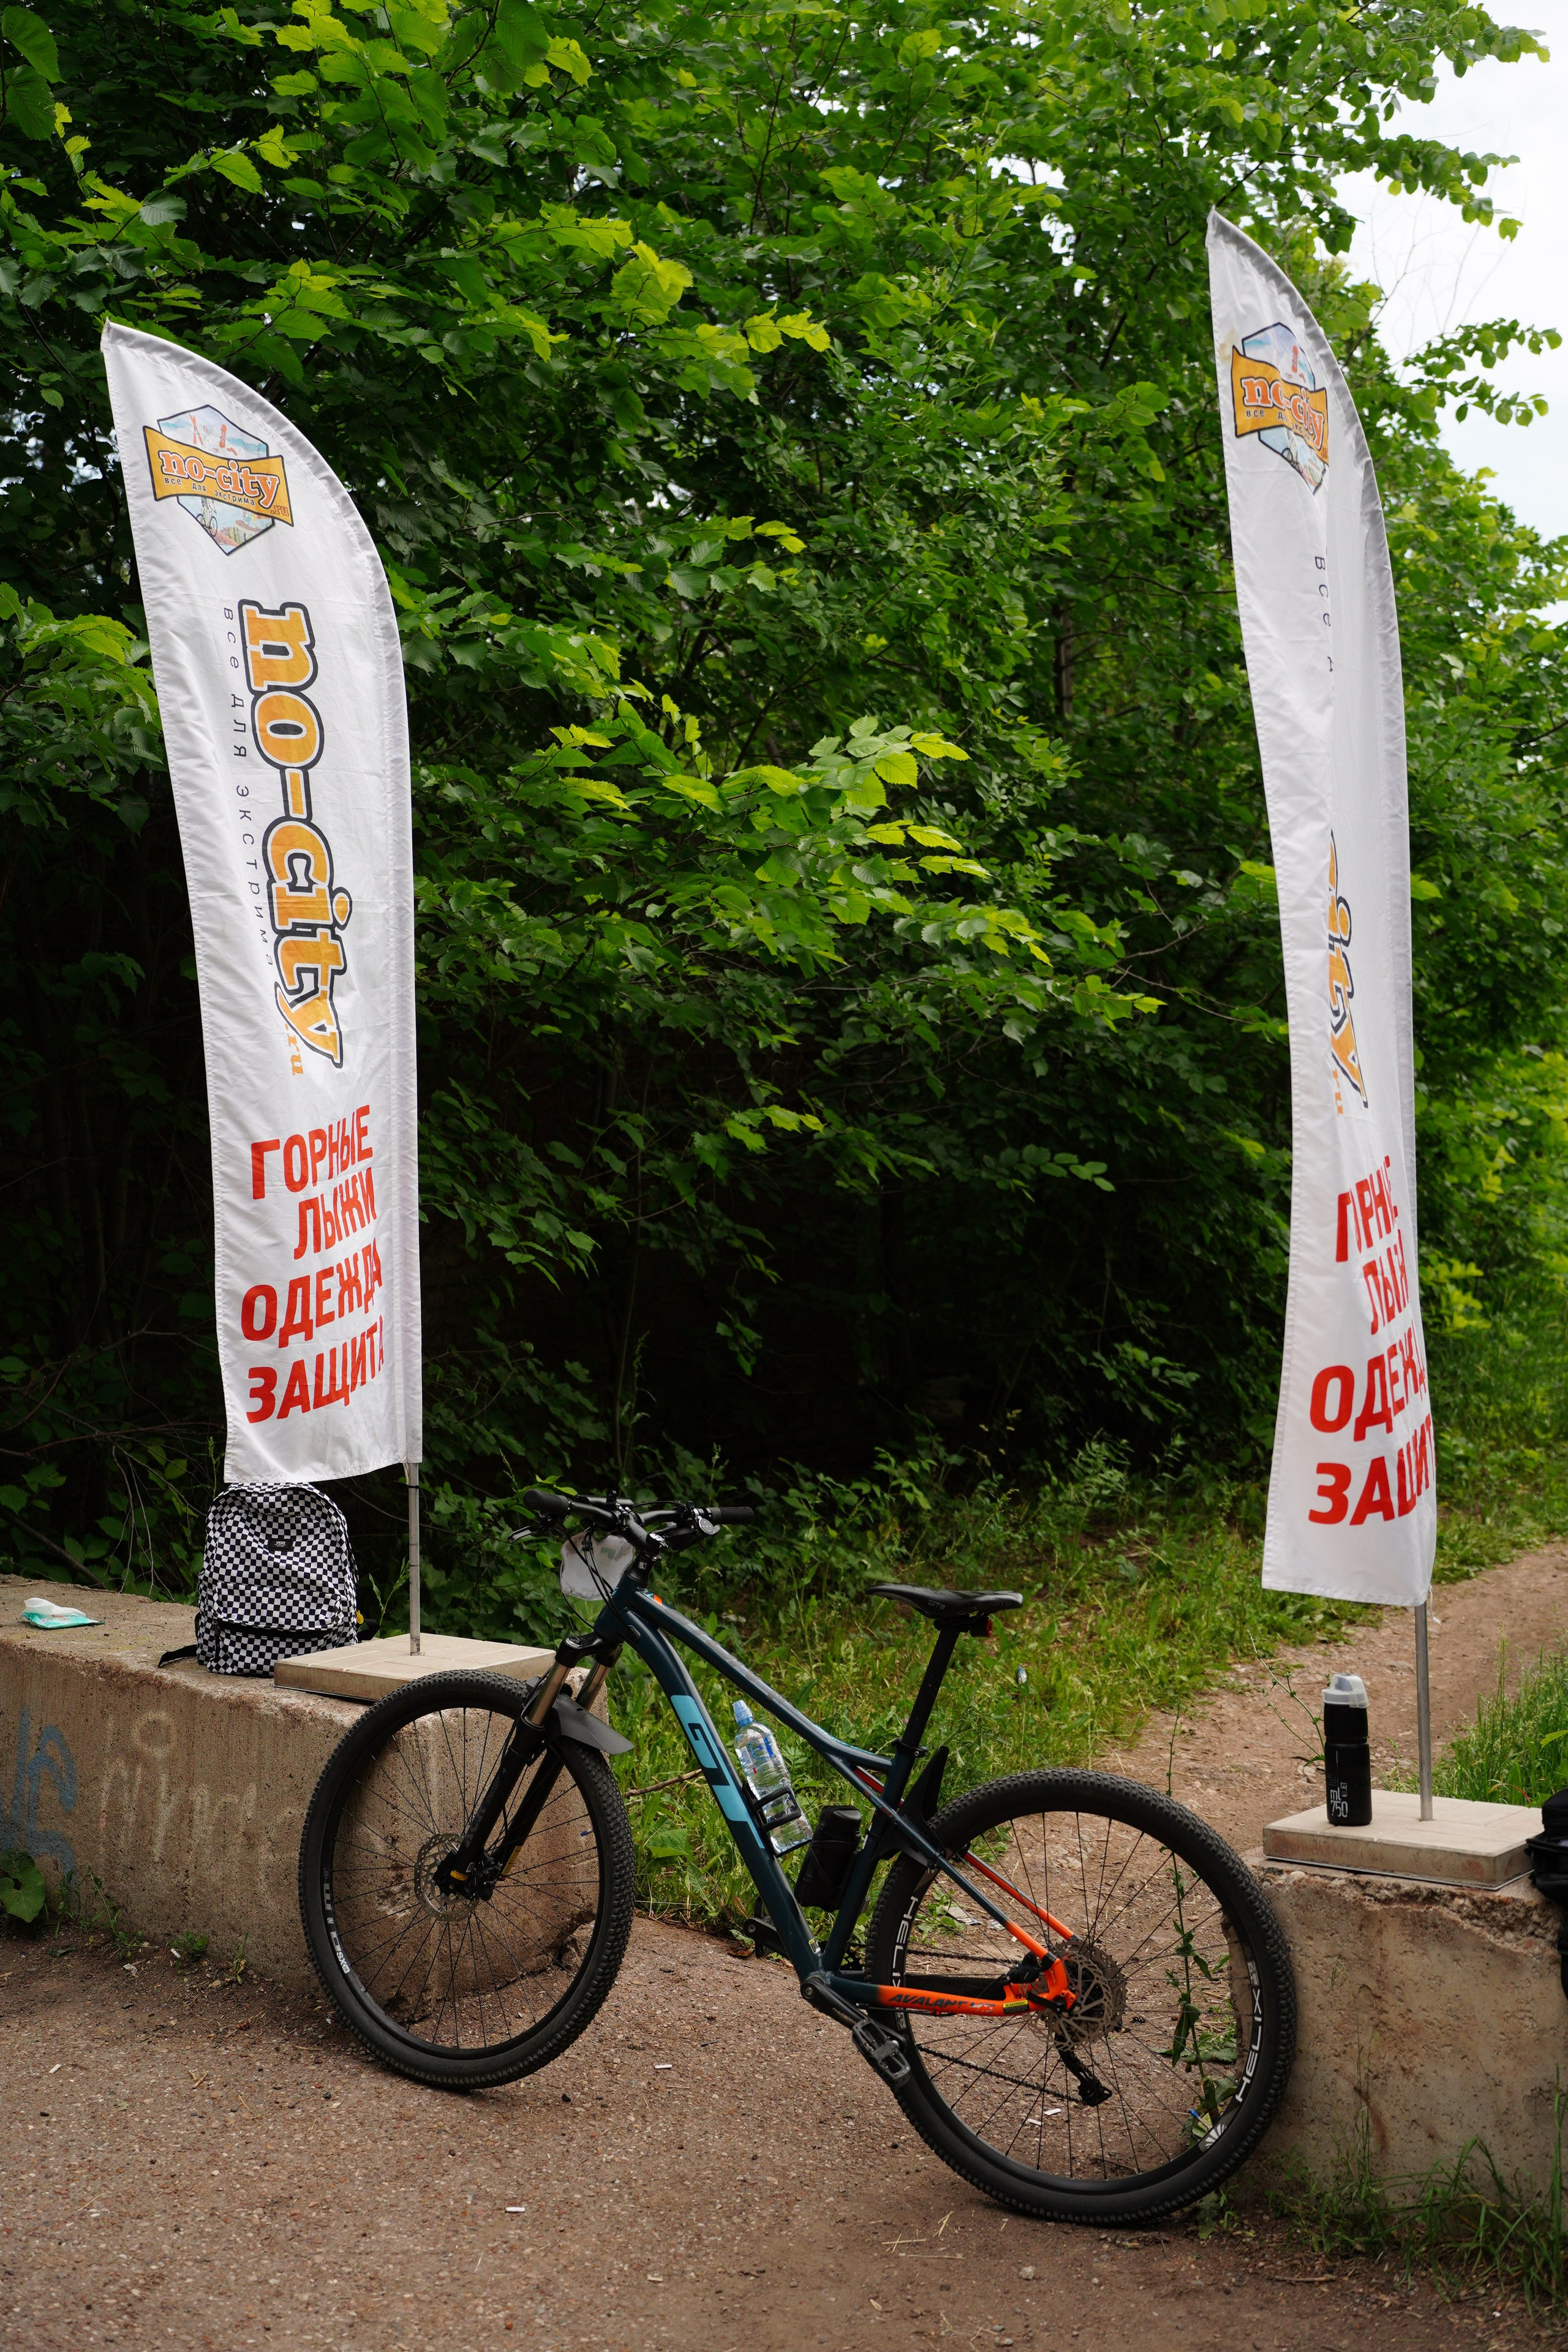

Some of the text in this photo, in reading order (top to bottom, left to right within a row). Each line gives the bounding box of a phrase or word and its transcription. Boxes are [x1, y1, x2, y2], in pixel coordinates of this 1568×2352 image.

[158, 451, 280, 509] no-city
[164, 477, 255, 506] все для экстрима
[231, 693, 247, 758] для
[236, 785, 273, 965] экстрима
[238, 599, 353, 1069] no-city
[251, 1104, 373, 1200] ГОРНЫЕ
[293, 1167, 377, 1260] ЛЫЖИ
[241, 1237, 383, 1349] ОДЕЖДА
[246, 1315, 384, 1423] ЗАЩИТА
[1235, 1988, 1262, 2103] HELIX
